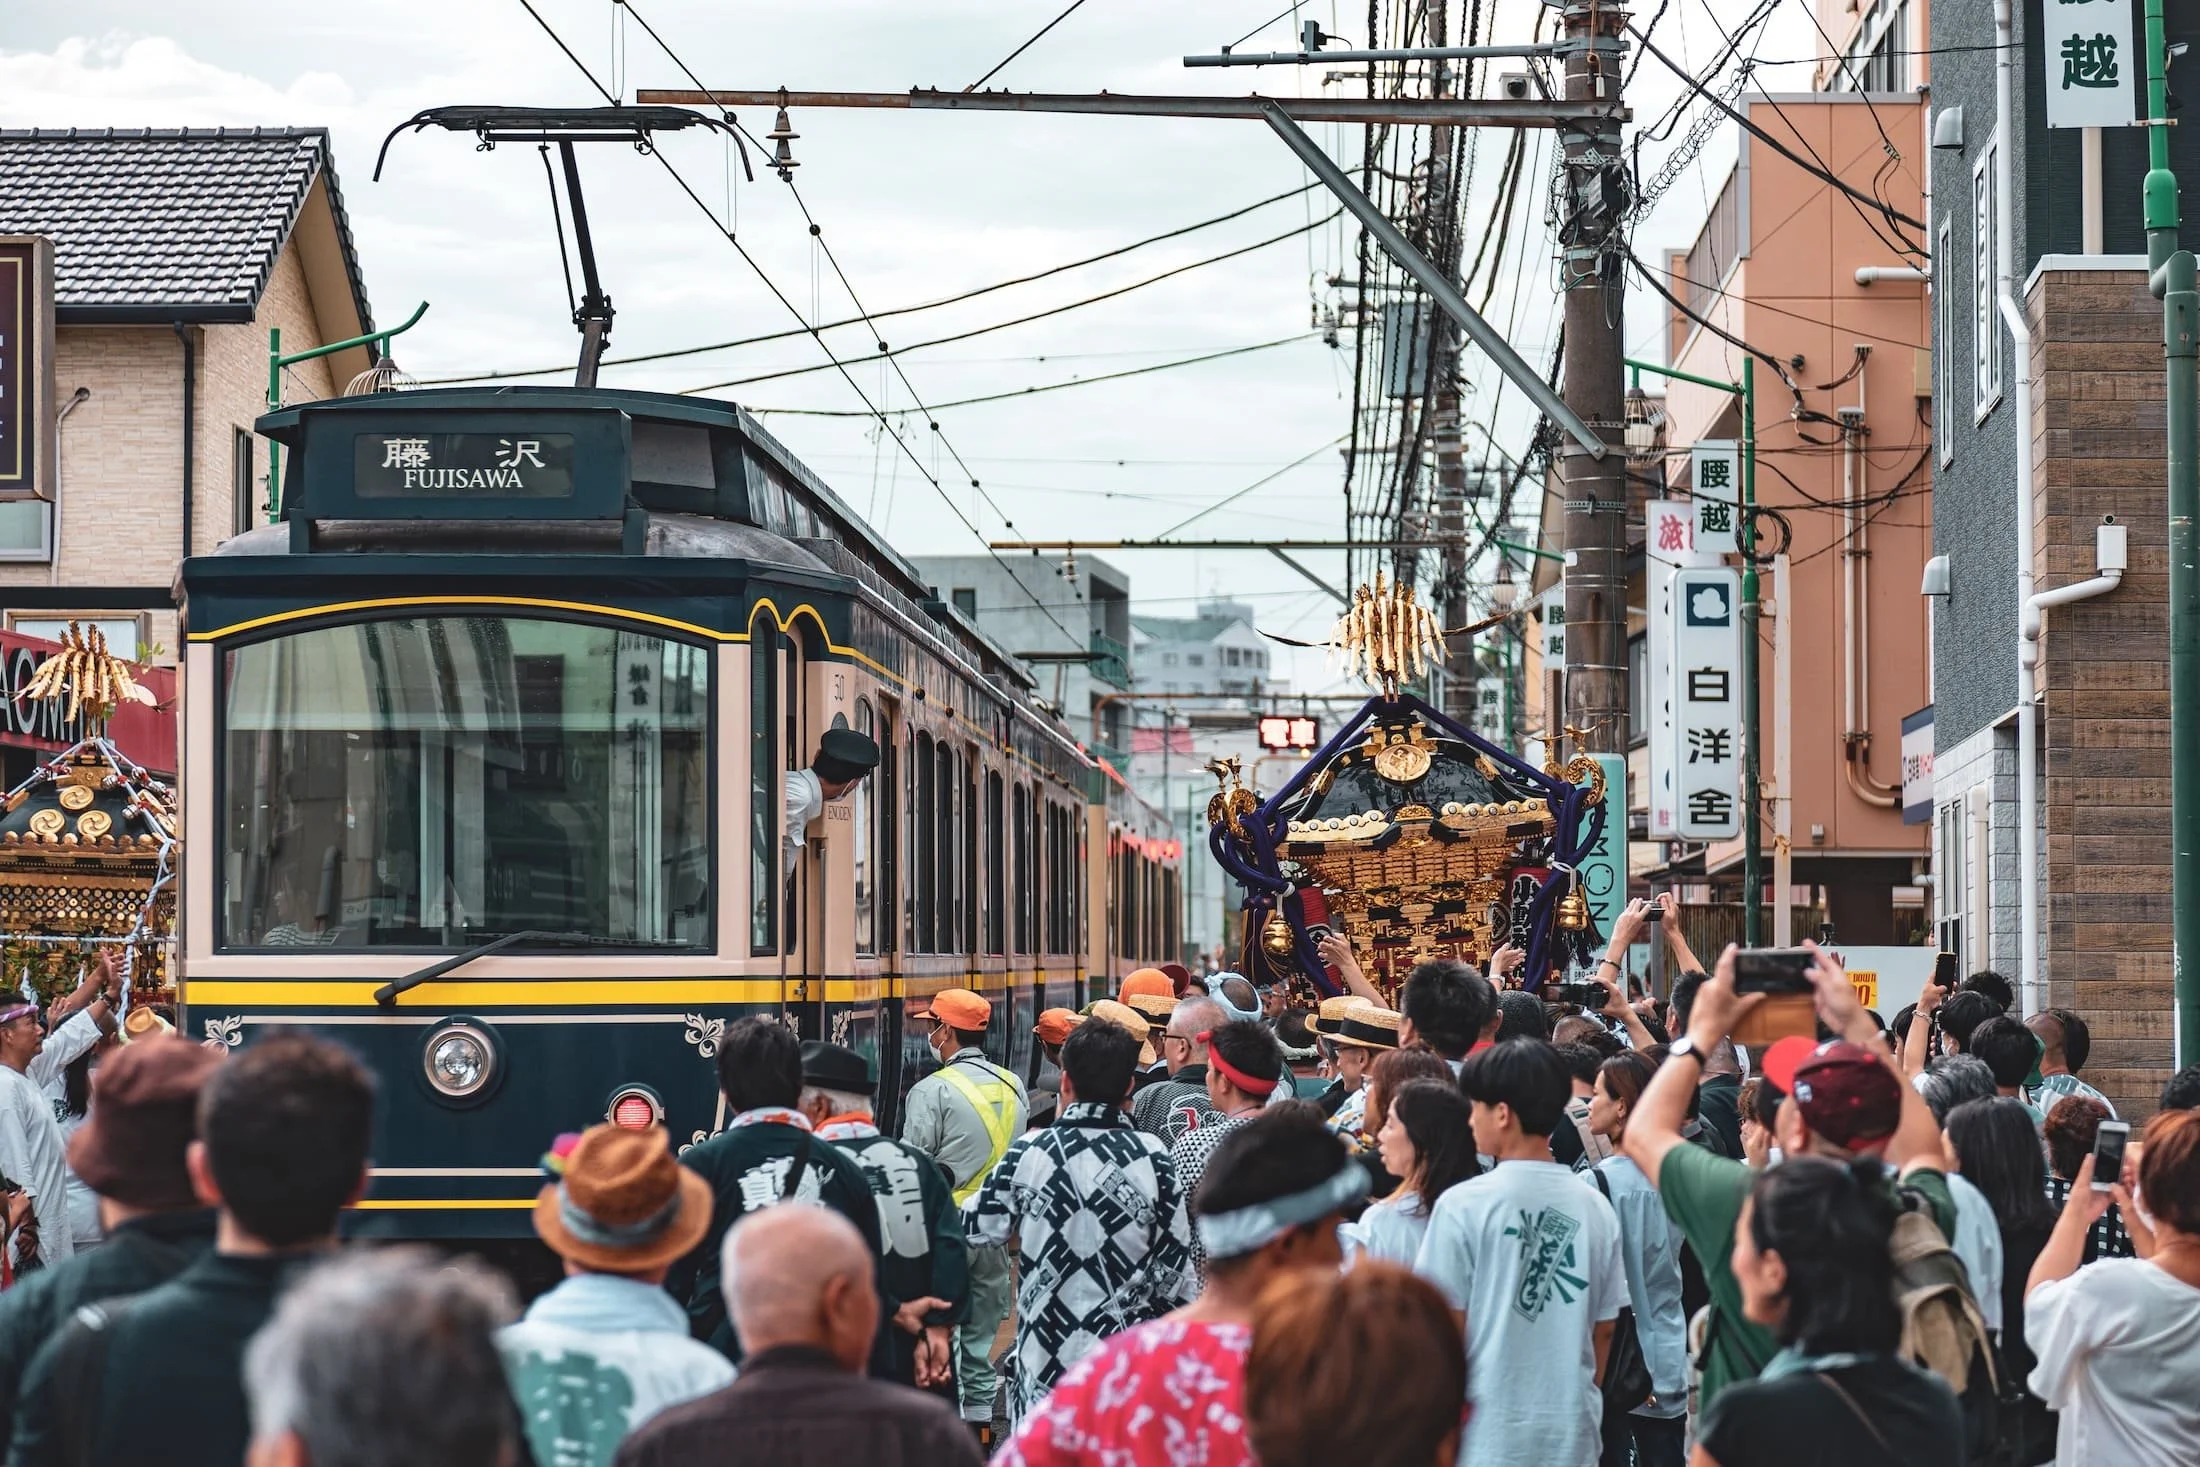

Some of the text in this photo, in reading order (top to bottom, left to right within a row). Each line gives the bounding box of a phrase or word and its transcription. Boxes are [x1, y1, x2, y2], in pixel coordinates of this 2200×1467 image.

[2059, 0, 2119, 90] 越
[382, 438, 546, 468] 藤沢
[404, 469, 524, 489] FUJISAWA
[1700, 459, 1731, 533] 腰越
[1658, 514, 1693, 551] 旅
